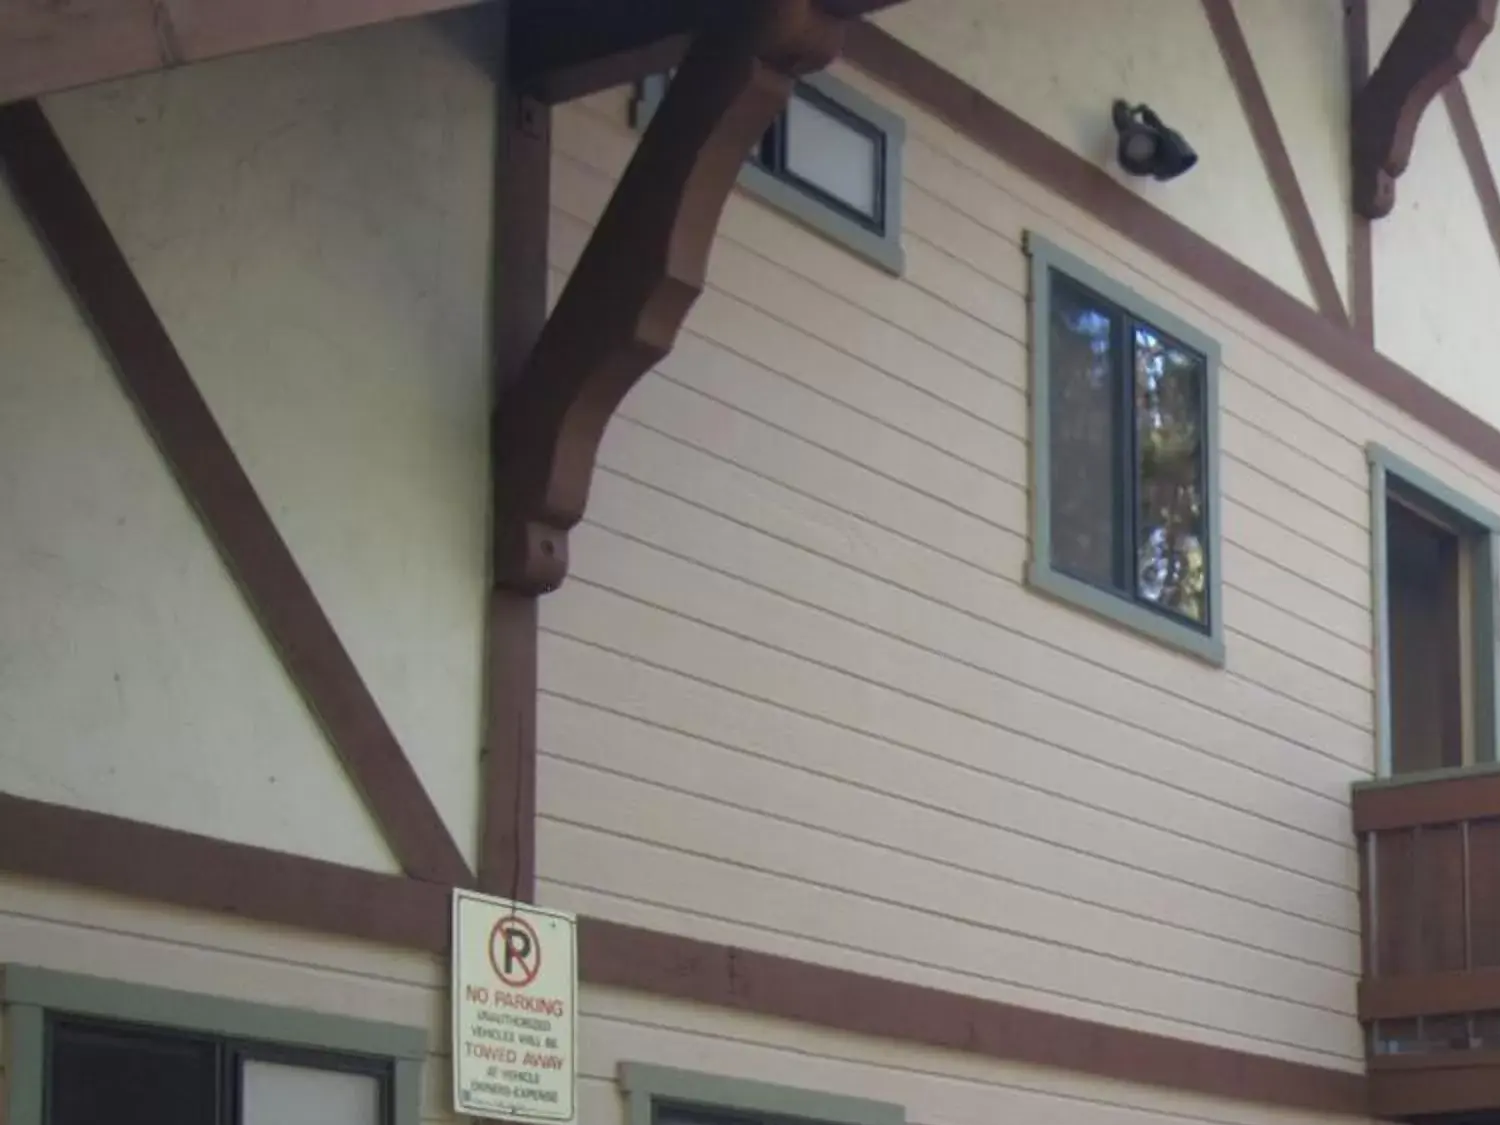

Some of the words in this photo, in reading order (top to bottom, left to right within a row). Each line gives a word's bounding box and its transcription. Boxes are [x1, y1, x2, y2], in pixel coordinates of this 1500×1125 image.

[466, 985, 489, 1006] NO
[494, 991, 564, 1017] PARKING
[477, 1011, 551, 1032] UNAUTHORIZED
[471, 1025, 515, 1043] VEHICLES
[518, 1033, 541, 1048] WILL
[465, 1041, 517, 1065] TOWED
[522, 1052, 564, 1071] AWAY
[502, 1069, 540, 1085] VEHICLE
[513, 1085, 558, 1104] EXPENSE
